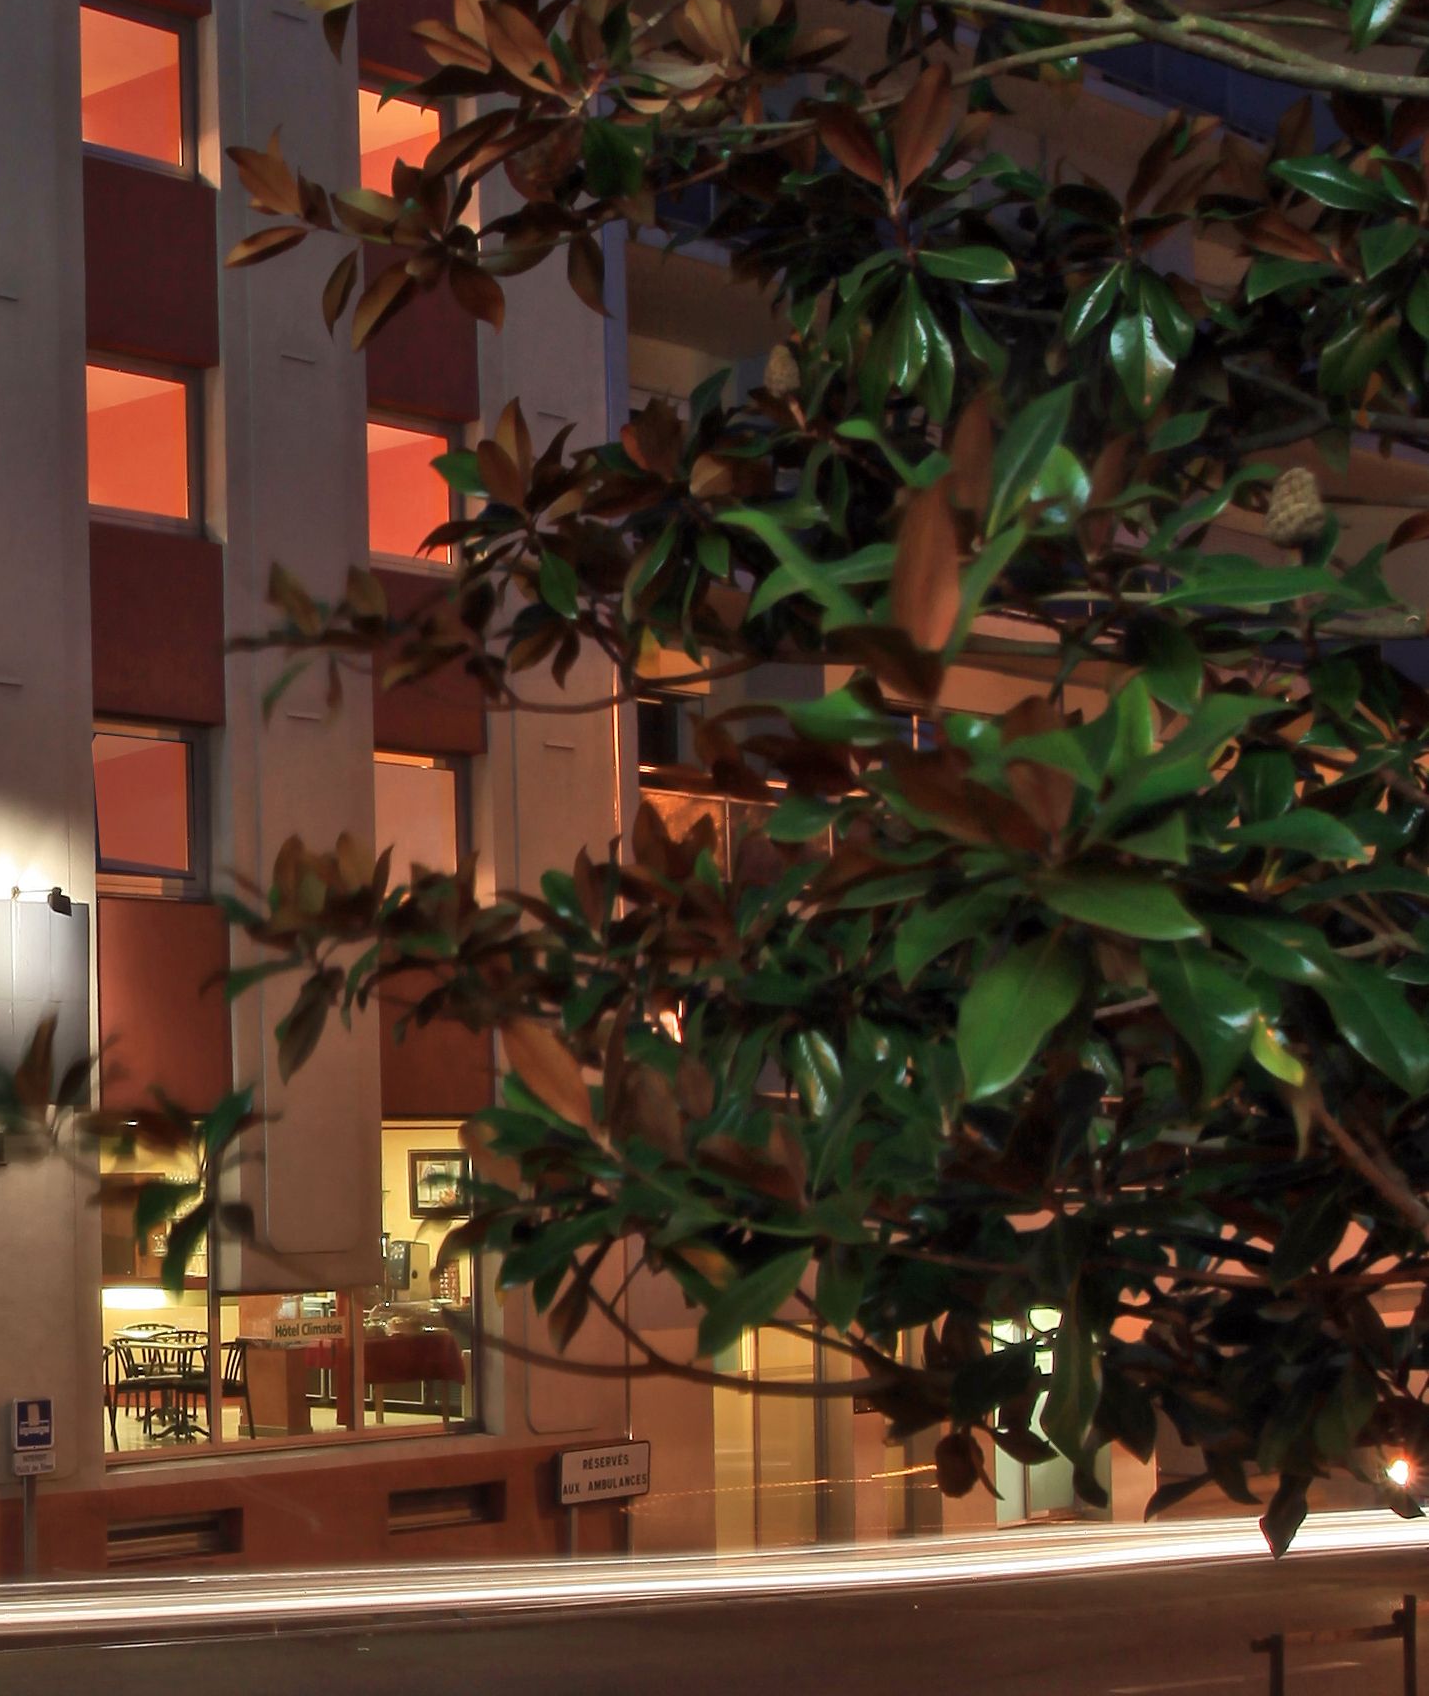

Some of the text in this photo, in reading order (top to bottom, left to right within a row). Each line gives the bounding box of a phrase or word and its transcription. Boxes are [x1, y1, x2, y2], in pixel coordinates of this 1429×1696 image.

[275, 1323, 299, 1337] Hôtel
[563, 1474, 647, 1495] AUX AMBULANCES
